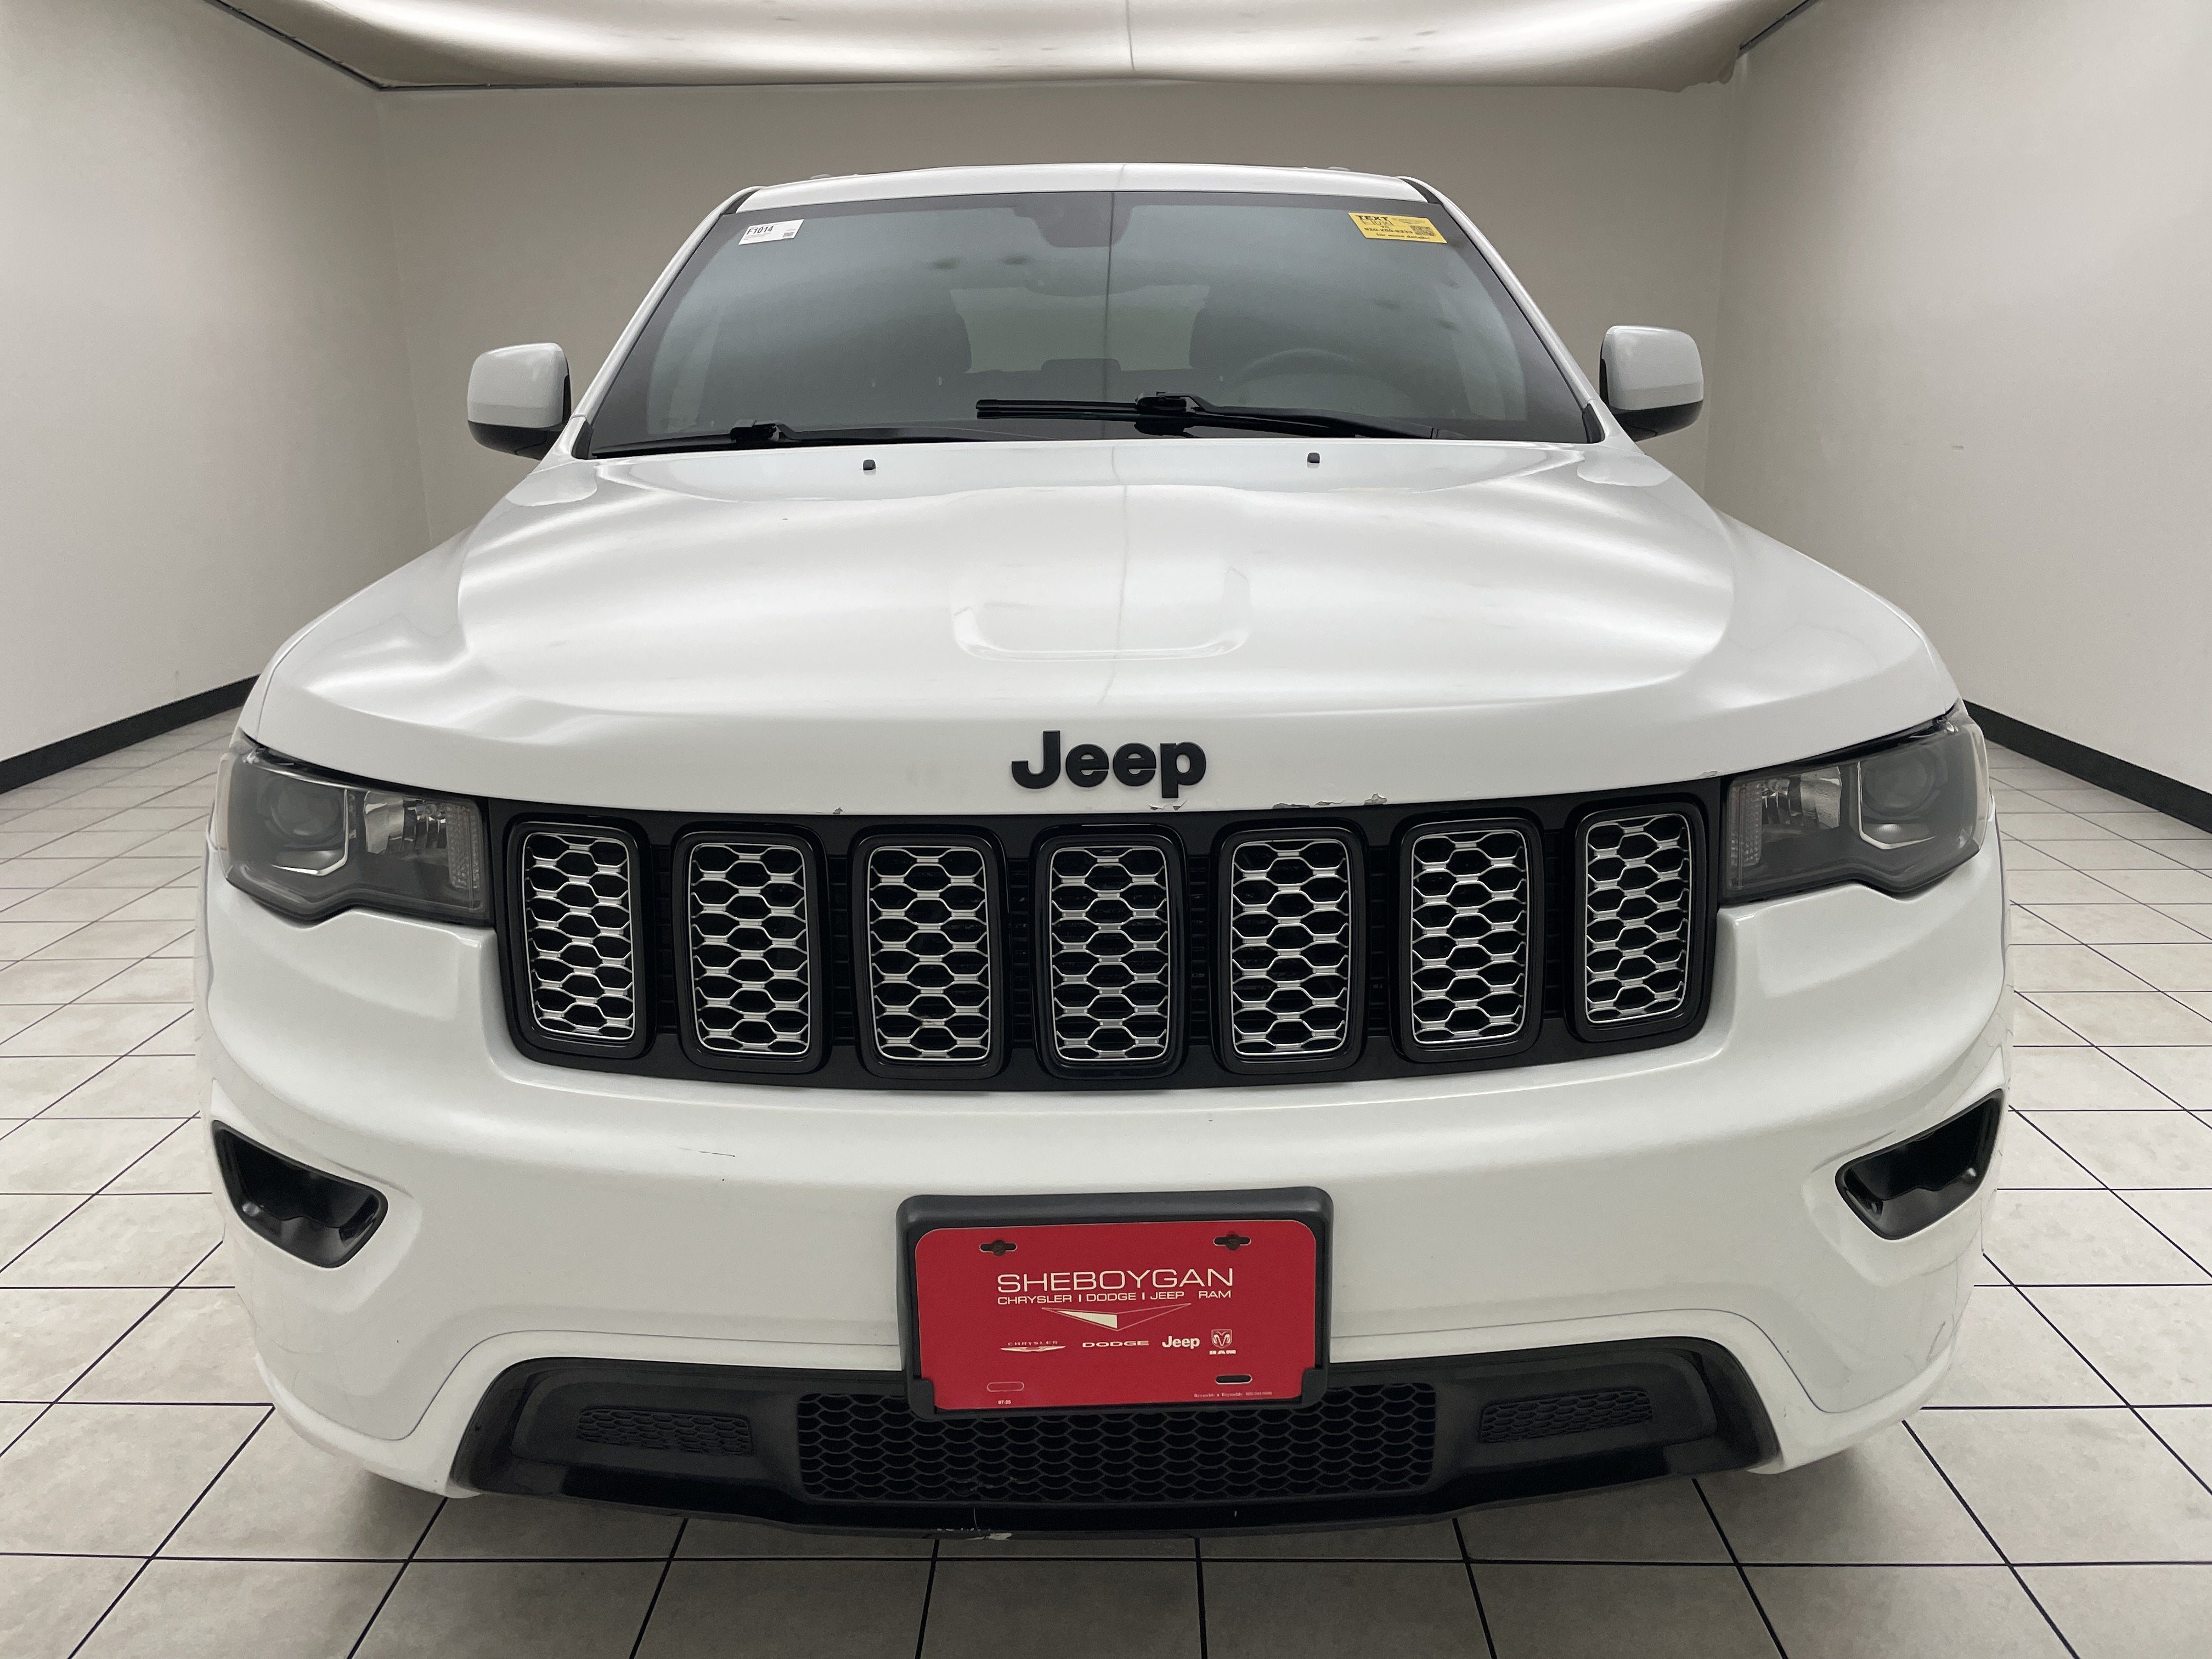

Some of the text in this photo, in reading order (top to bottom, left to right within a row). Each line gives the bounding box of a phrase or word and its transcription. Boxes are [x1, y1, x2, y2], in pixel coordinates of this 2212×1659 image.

[746, 225, 774, 235] F1014
[1012, 730, 1206, 798] Jeep
[997, 1268, 1233, 1293] SHEBOYGAN
[997, 1294, 1073, 1305] CHRYSLER
[1086, 1292, 1137, 1302] DODGE
[1150, 1291, 1185, 1300] JEEP
[1198, 1290, 1231, 1299] RAM
[1082, 1340, 1149, 1348] DODGE
[1161, 1335, 1200, 1350] Jeep
